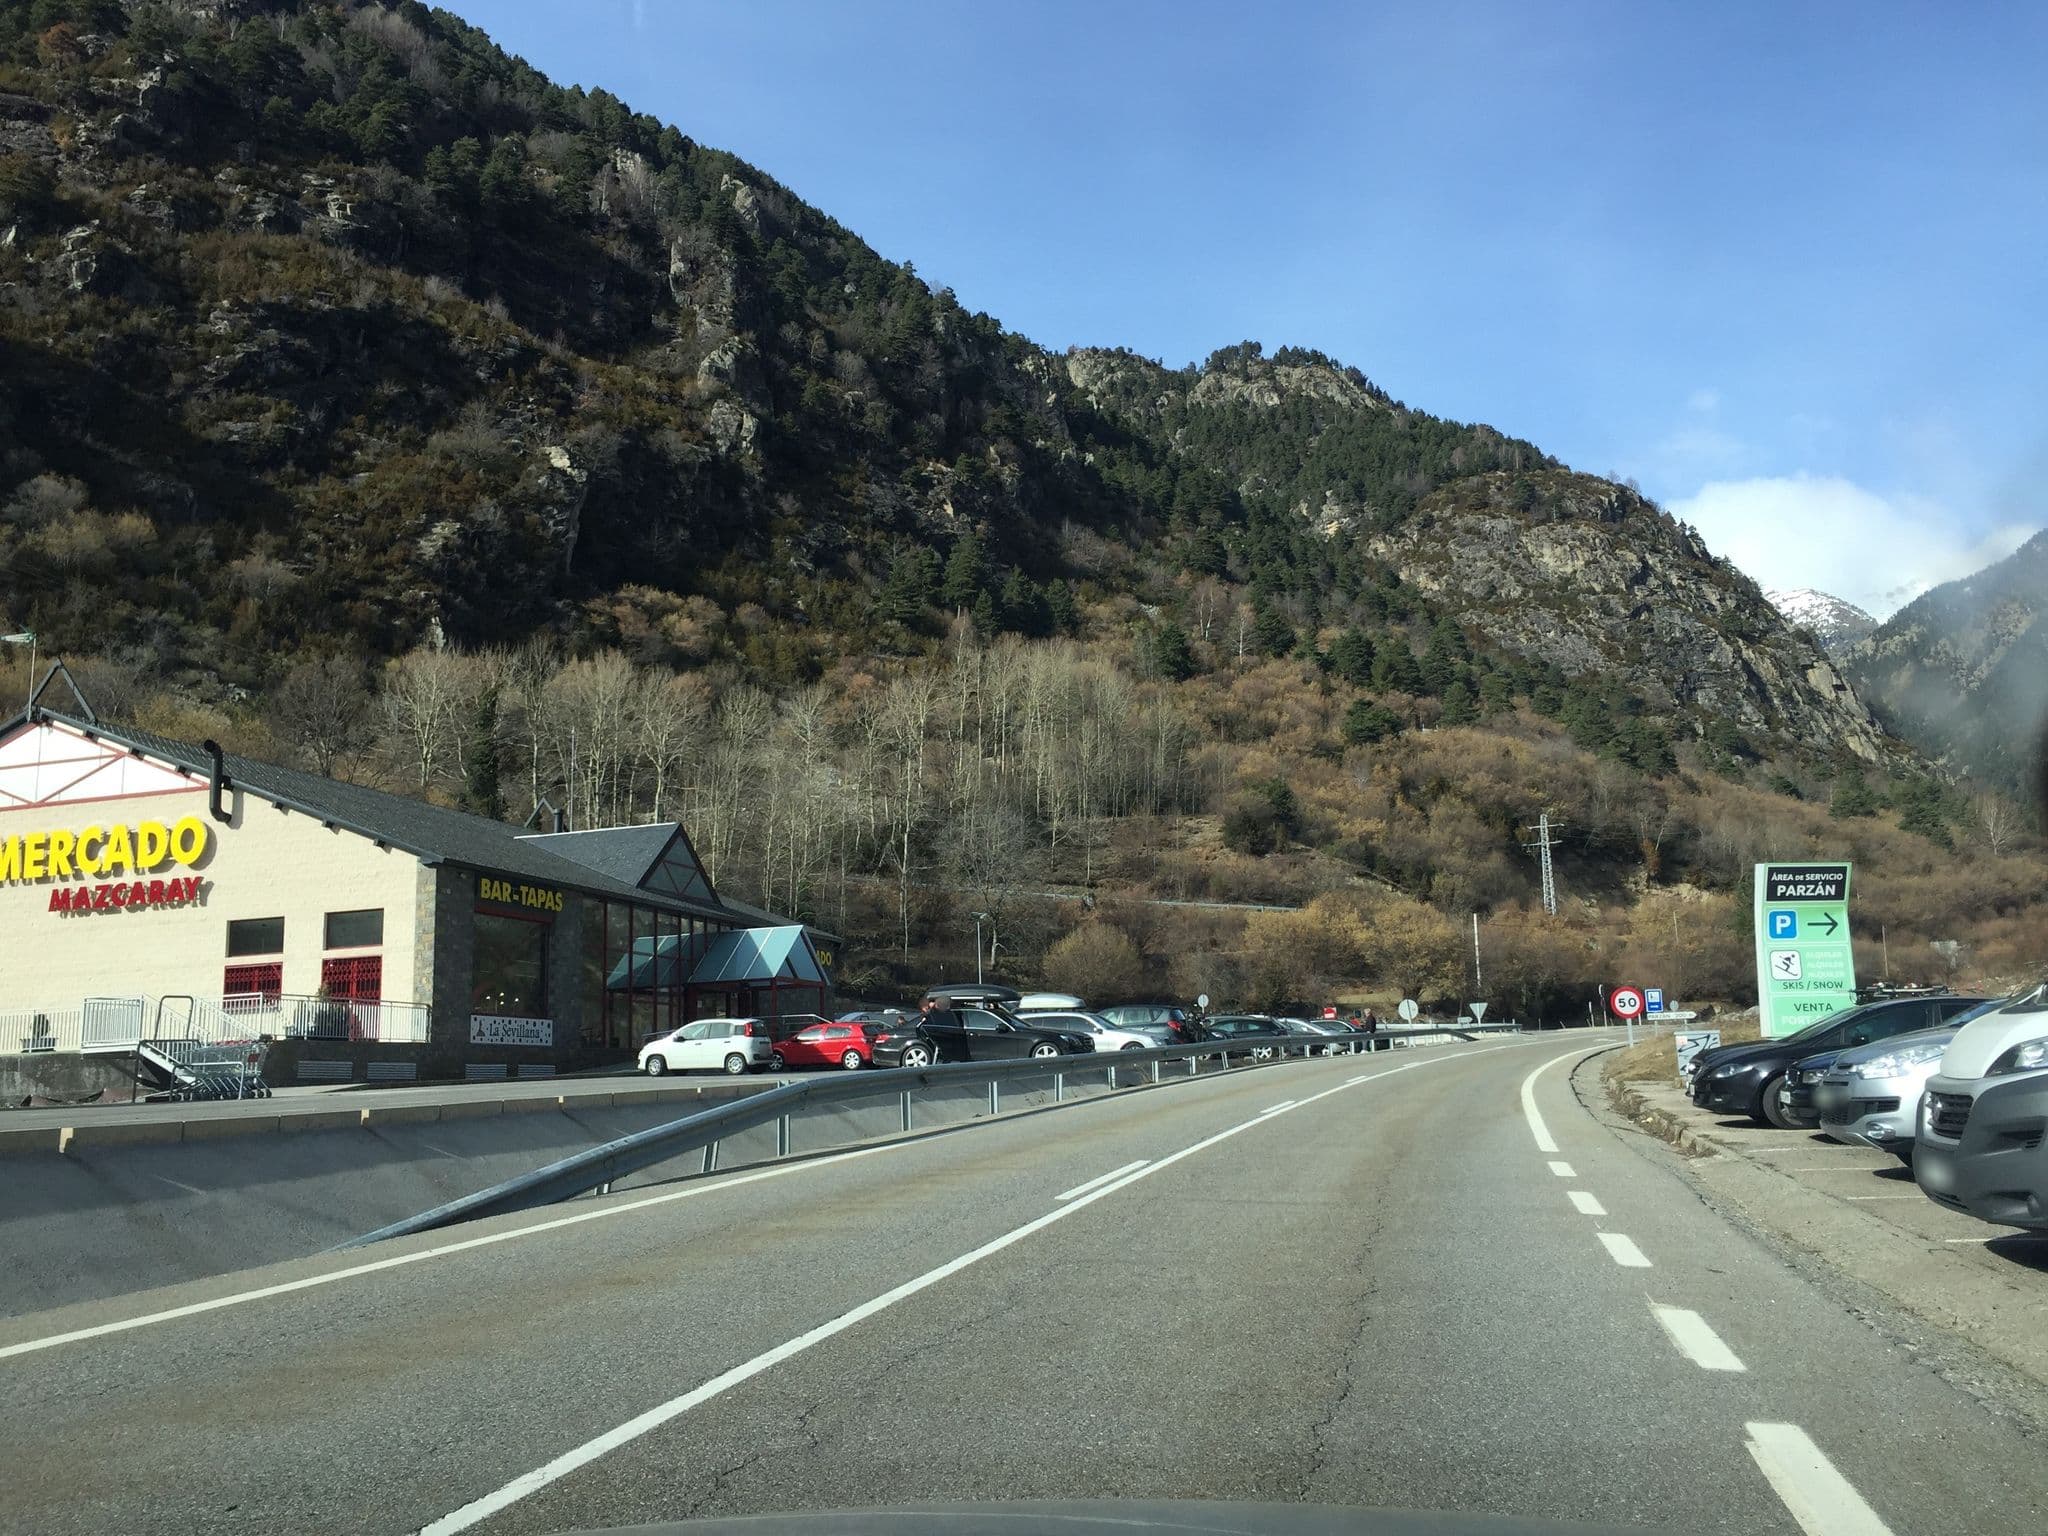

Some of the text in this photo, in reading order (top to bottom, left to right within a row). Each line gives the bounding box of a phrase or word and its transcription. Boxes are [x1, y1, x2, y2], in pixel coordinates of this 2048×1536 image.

[1771, 872, 1794, 881] ÁREA
[1805, 873, 1843, 881] SERVICIO
[48, 876, 204, 912] MAZCARAY
[1777, 881, 1836, 896] PARZÁN
[1776, 915, 1791, 935] P
[1783, 981, 1804, 990] SKIS
[1813, 981, 1843, 989] SNOW
[1618, 997, 1637, 1008] 50
[1794, 1003, 1833, 1012] VENTA
[489, 1023, 540, 1038] La Sevillana
